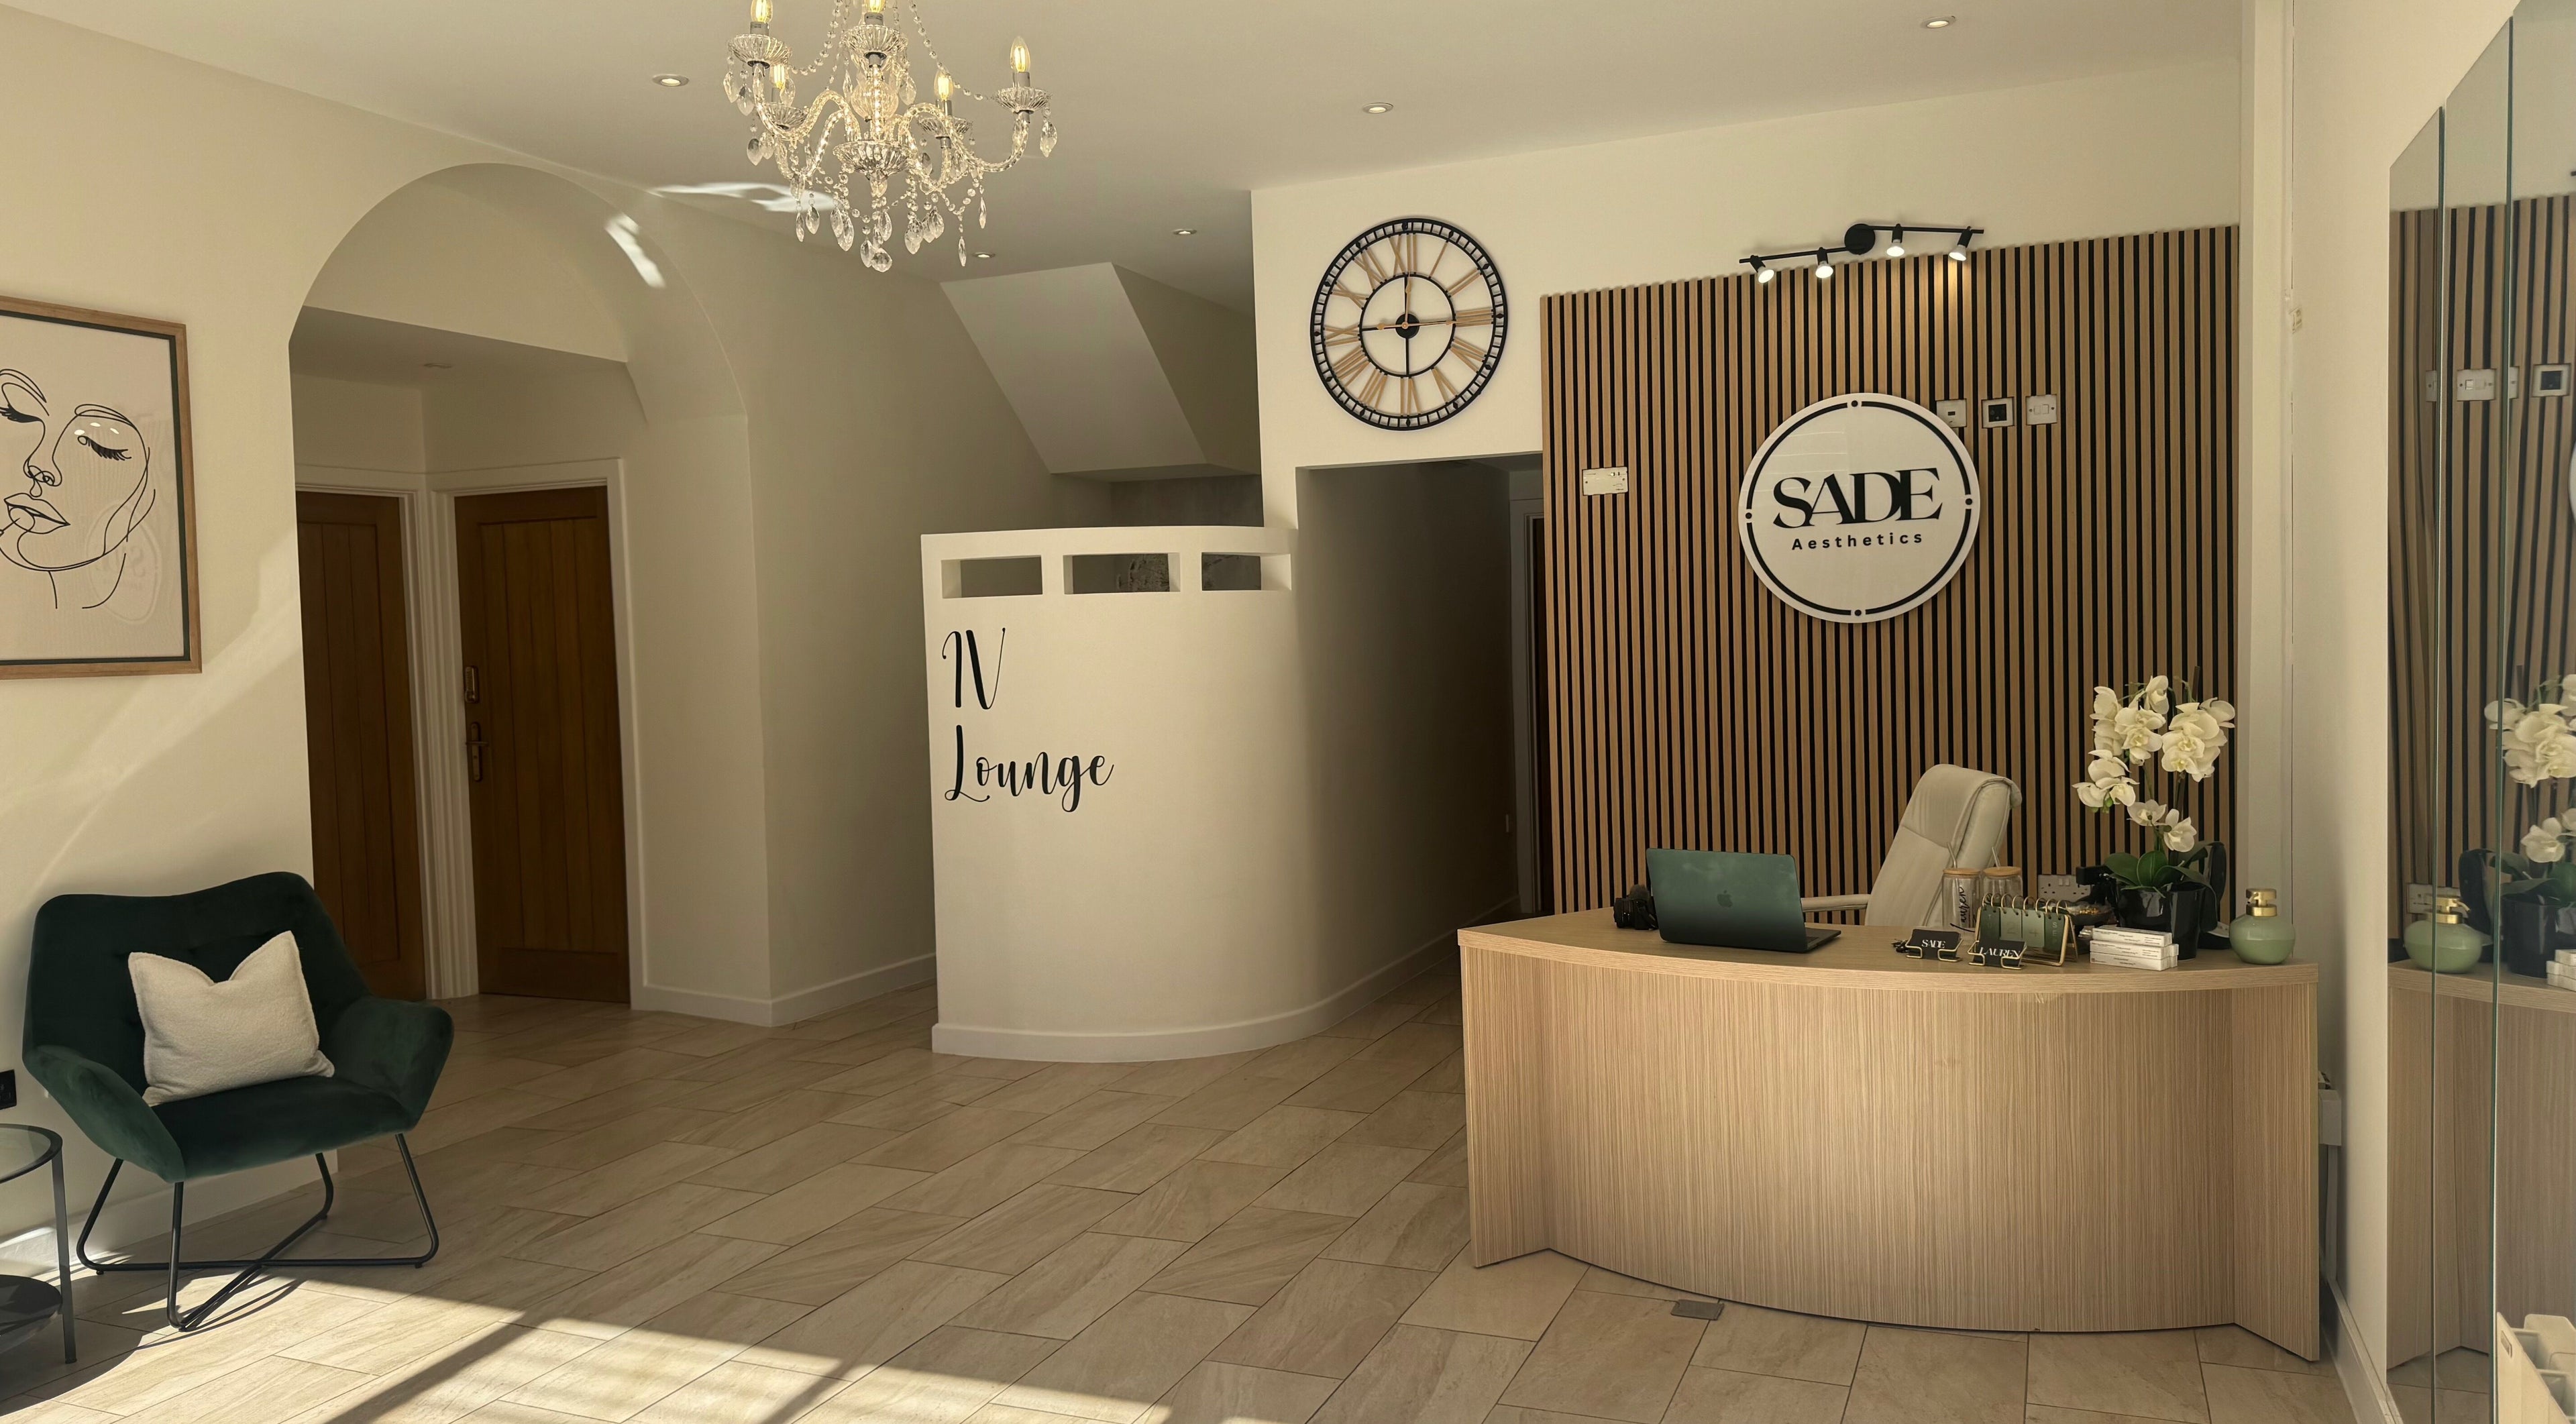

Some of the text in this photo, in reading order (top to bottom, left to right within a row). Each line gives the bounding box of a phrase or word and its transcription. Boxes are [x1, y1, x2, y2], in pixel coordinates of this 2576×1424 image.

[1772, 467, 1943, 529] SADE
[1791, 532, 1923, 551] Aesthetics
[942, 627, 1006, 710] IV
[945, 724, 1114, 812] Lounge
[1921, 939, 1947, 949] SADE
[1979, 946, 2021, 958] LAUREN
